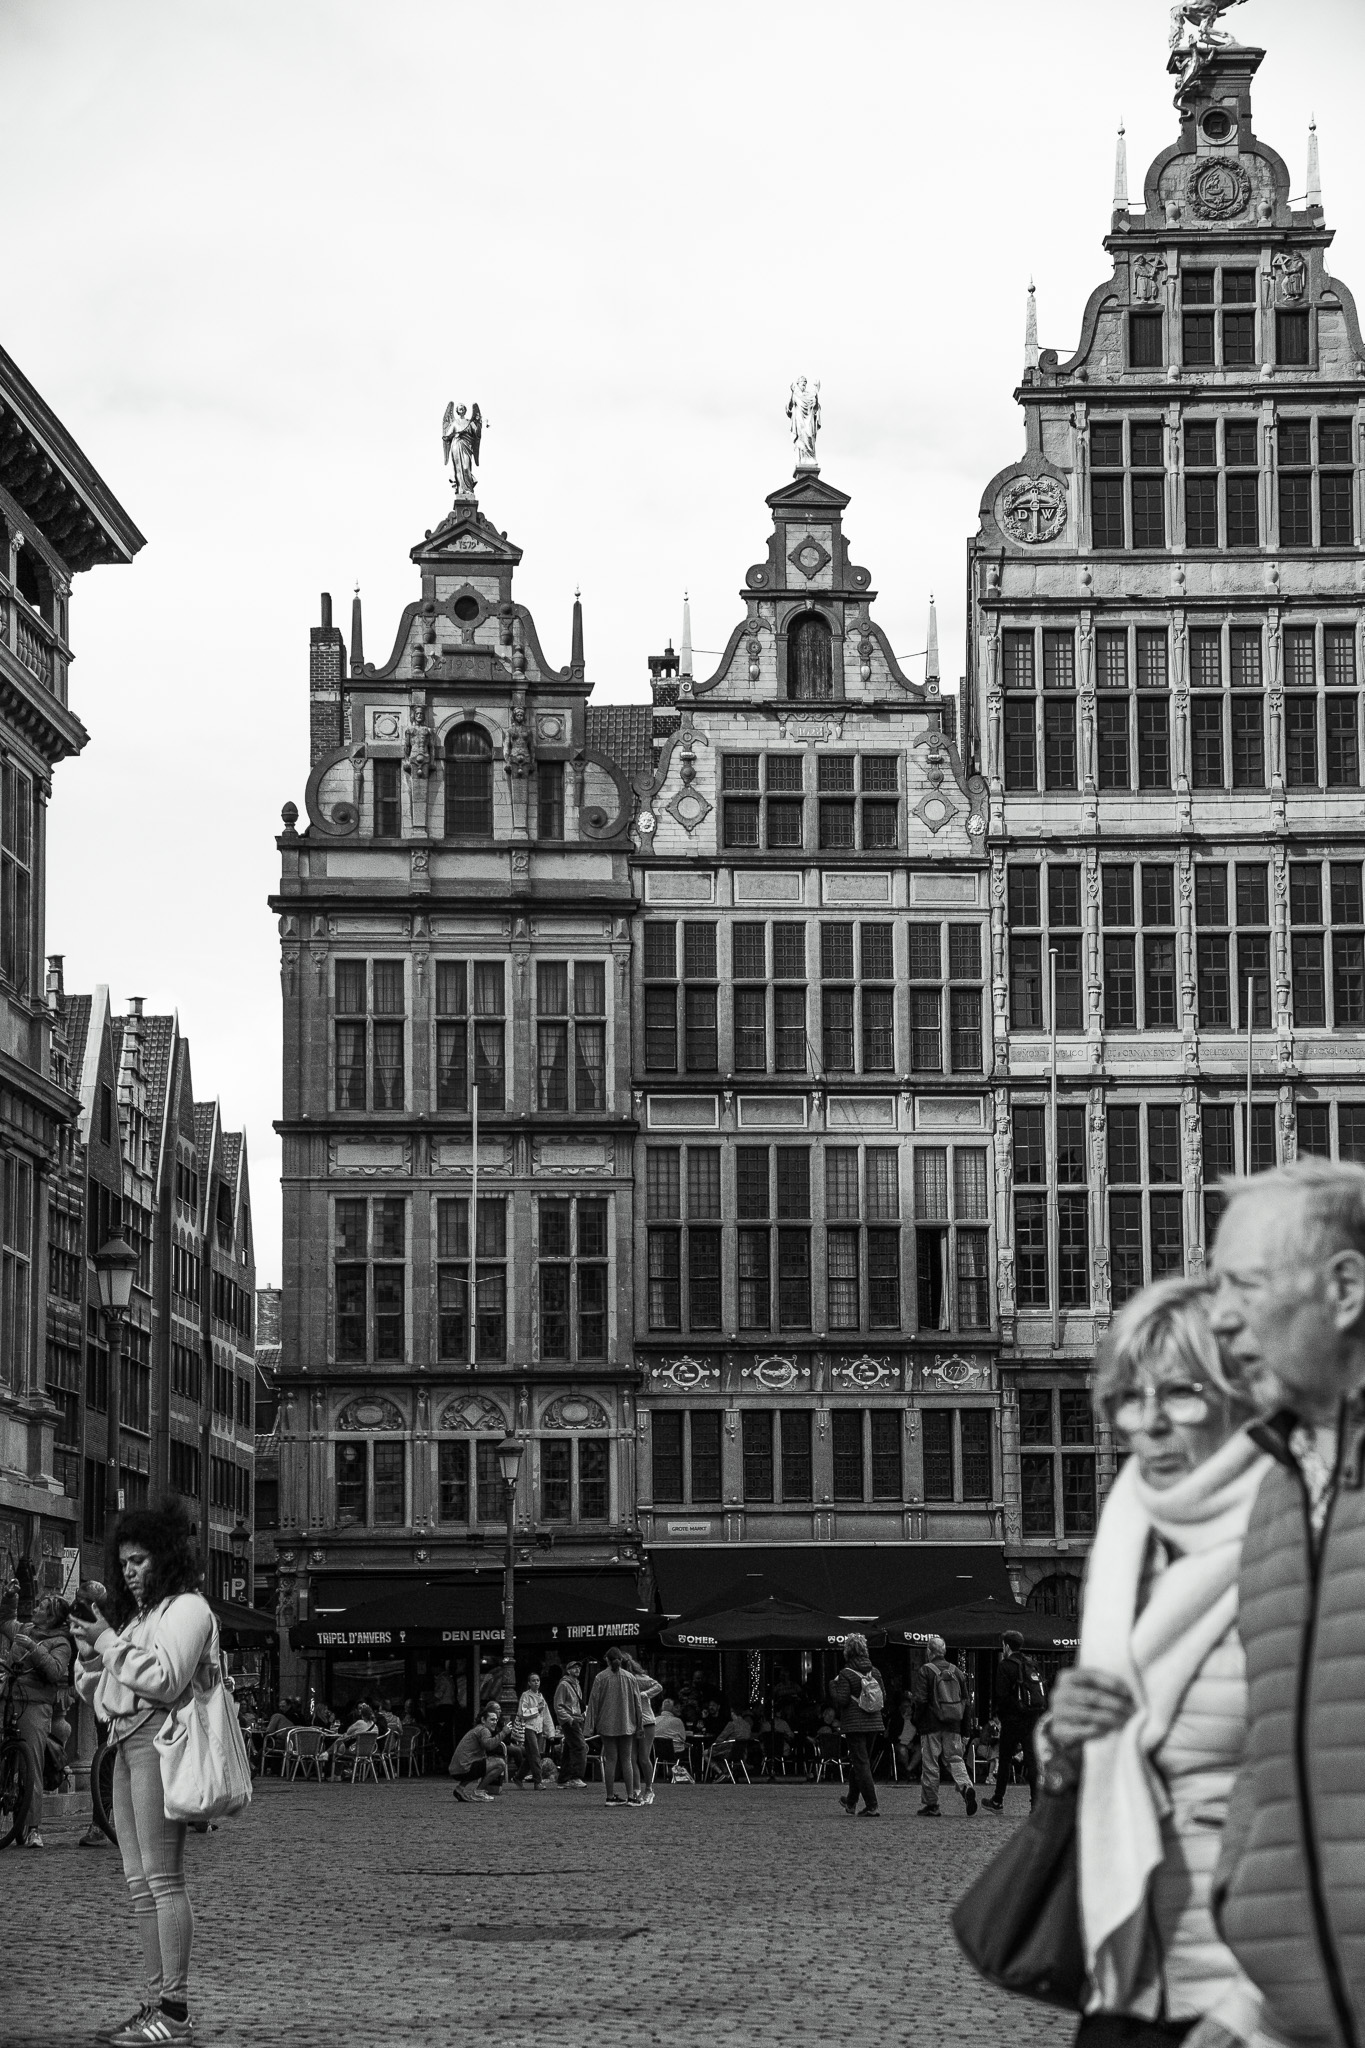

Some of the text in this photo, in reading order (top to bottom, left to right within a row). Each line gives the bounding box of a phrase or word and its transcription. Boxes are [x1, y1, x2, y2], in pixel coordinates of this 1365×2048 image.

[1018, 509, 1055, 520] D W
[450, 659, 486, 670] 1900
[944, 1366, 967, 1379] 1579
[231, 1578, 246, 1597] P
[442, 1629, 517, 1641] DEN ENGE
[566, 1623, 640, 1638] TRIPEL D'ANVERS
[317, 1631, 392, 1644] TRIPEL D'ANVERS
